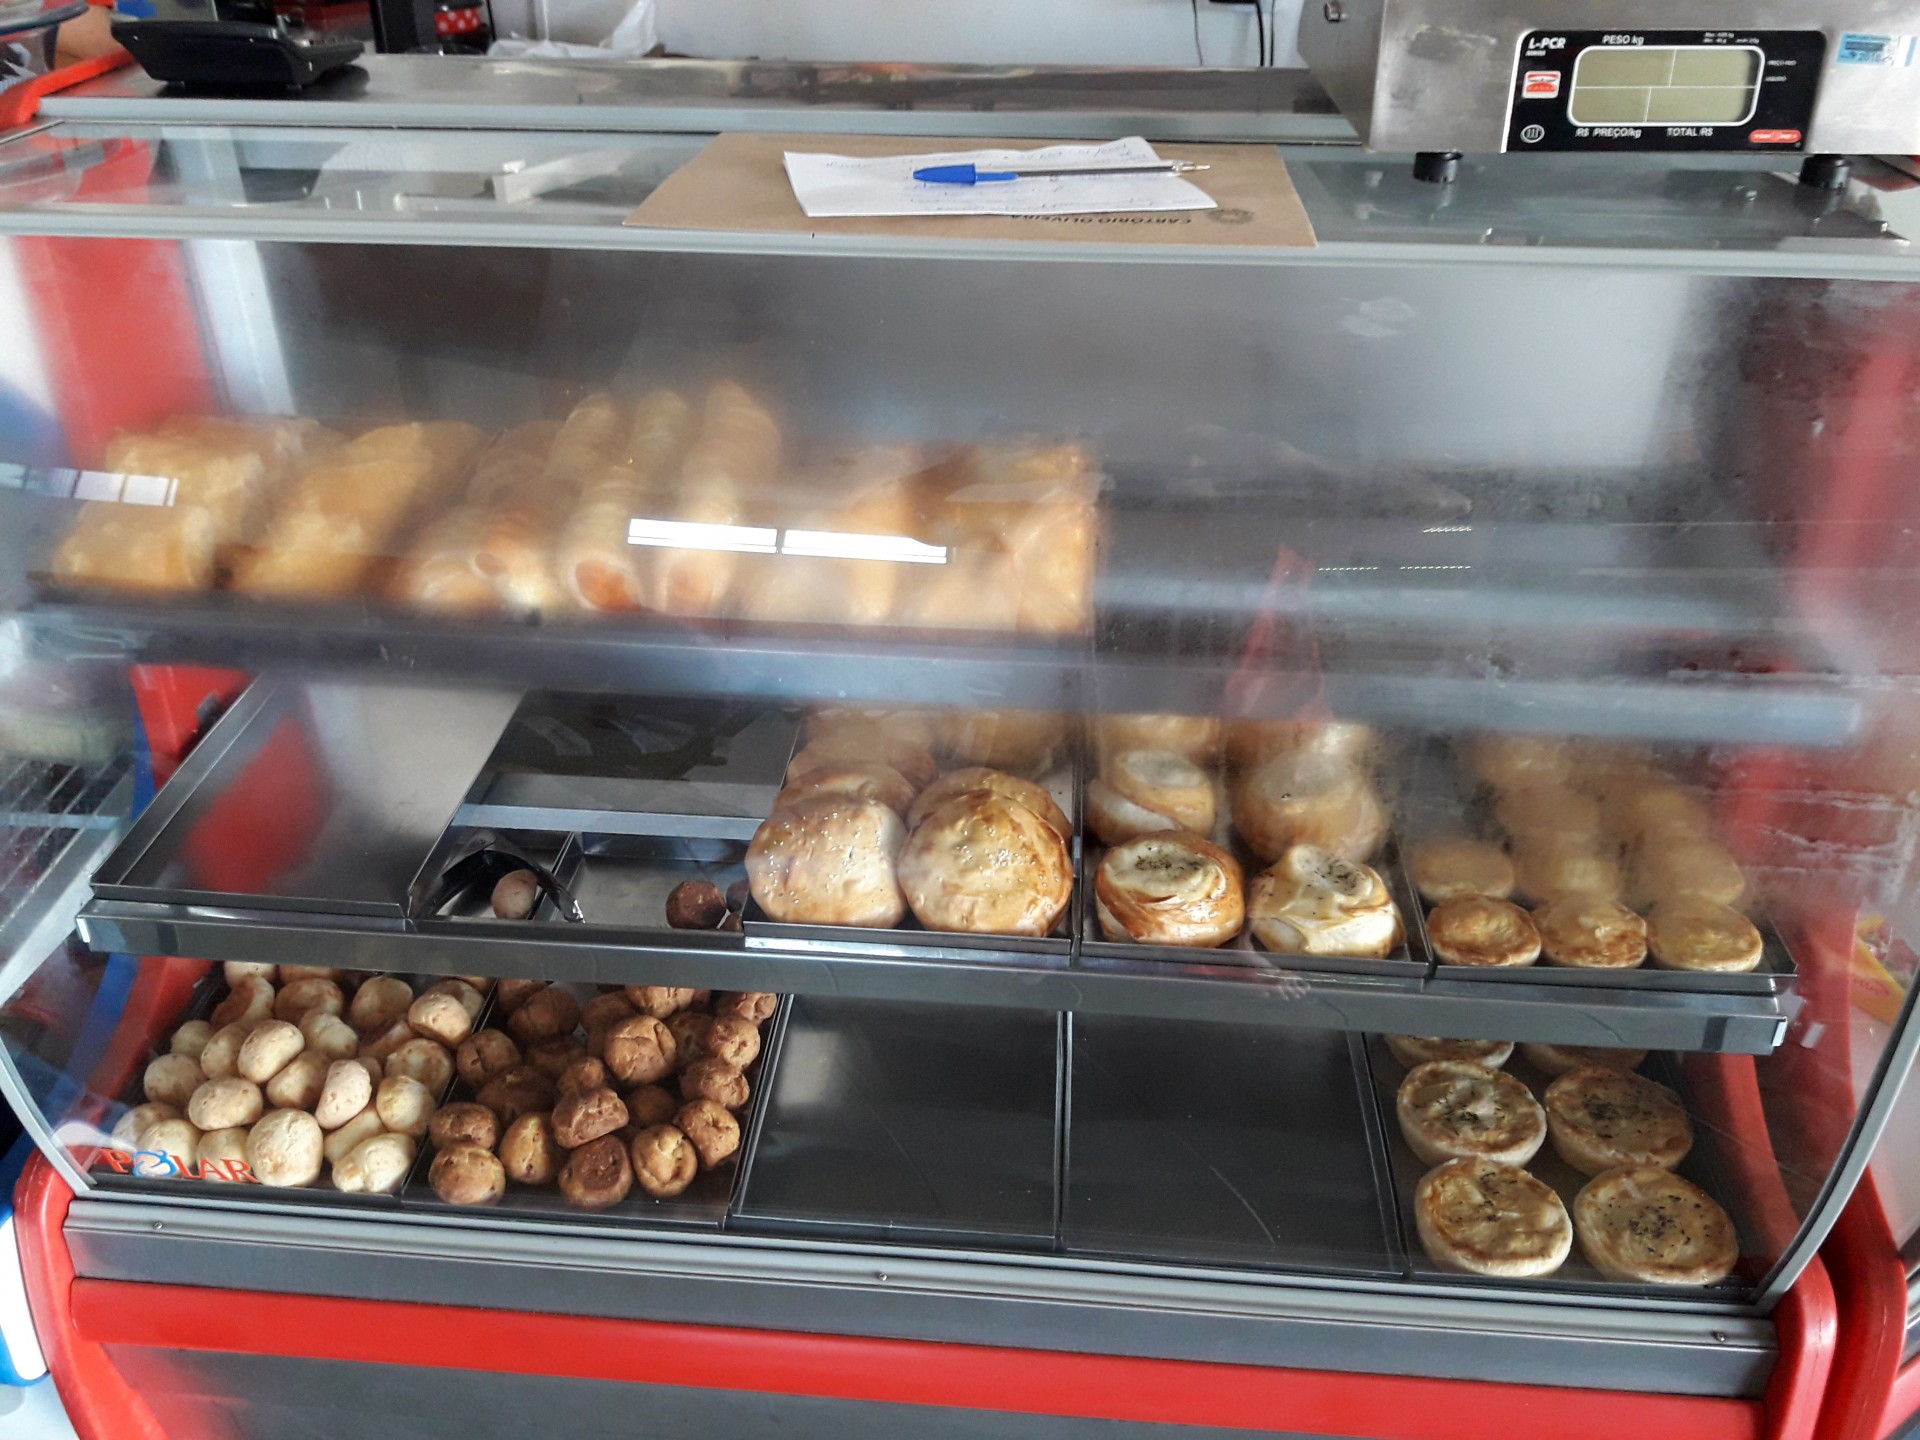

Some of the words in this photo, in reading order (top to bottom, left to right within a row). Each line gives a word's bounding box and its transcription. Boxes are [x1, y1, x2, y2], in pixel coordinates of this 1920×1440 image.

[1528, 37, 1566, 49] L-PCR
[1602, 35, 1630, 44] PESO
[1631, 35, 1644, 46] kg
[1667, 128, 1698, 137] TOTAL
[100, 1148, 264, 1185] POLAR
